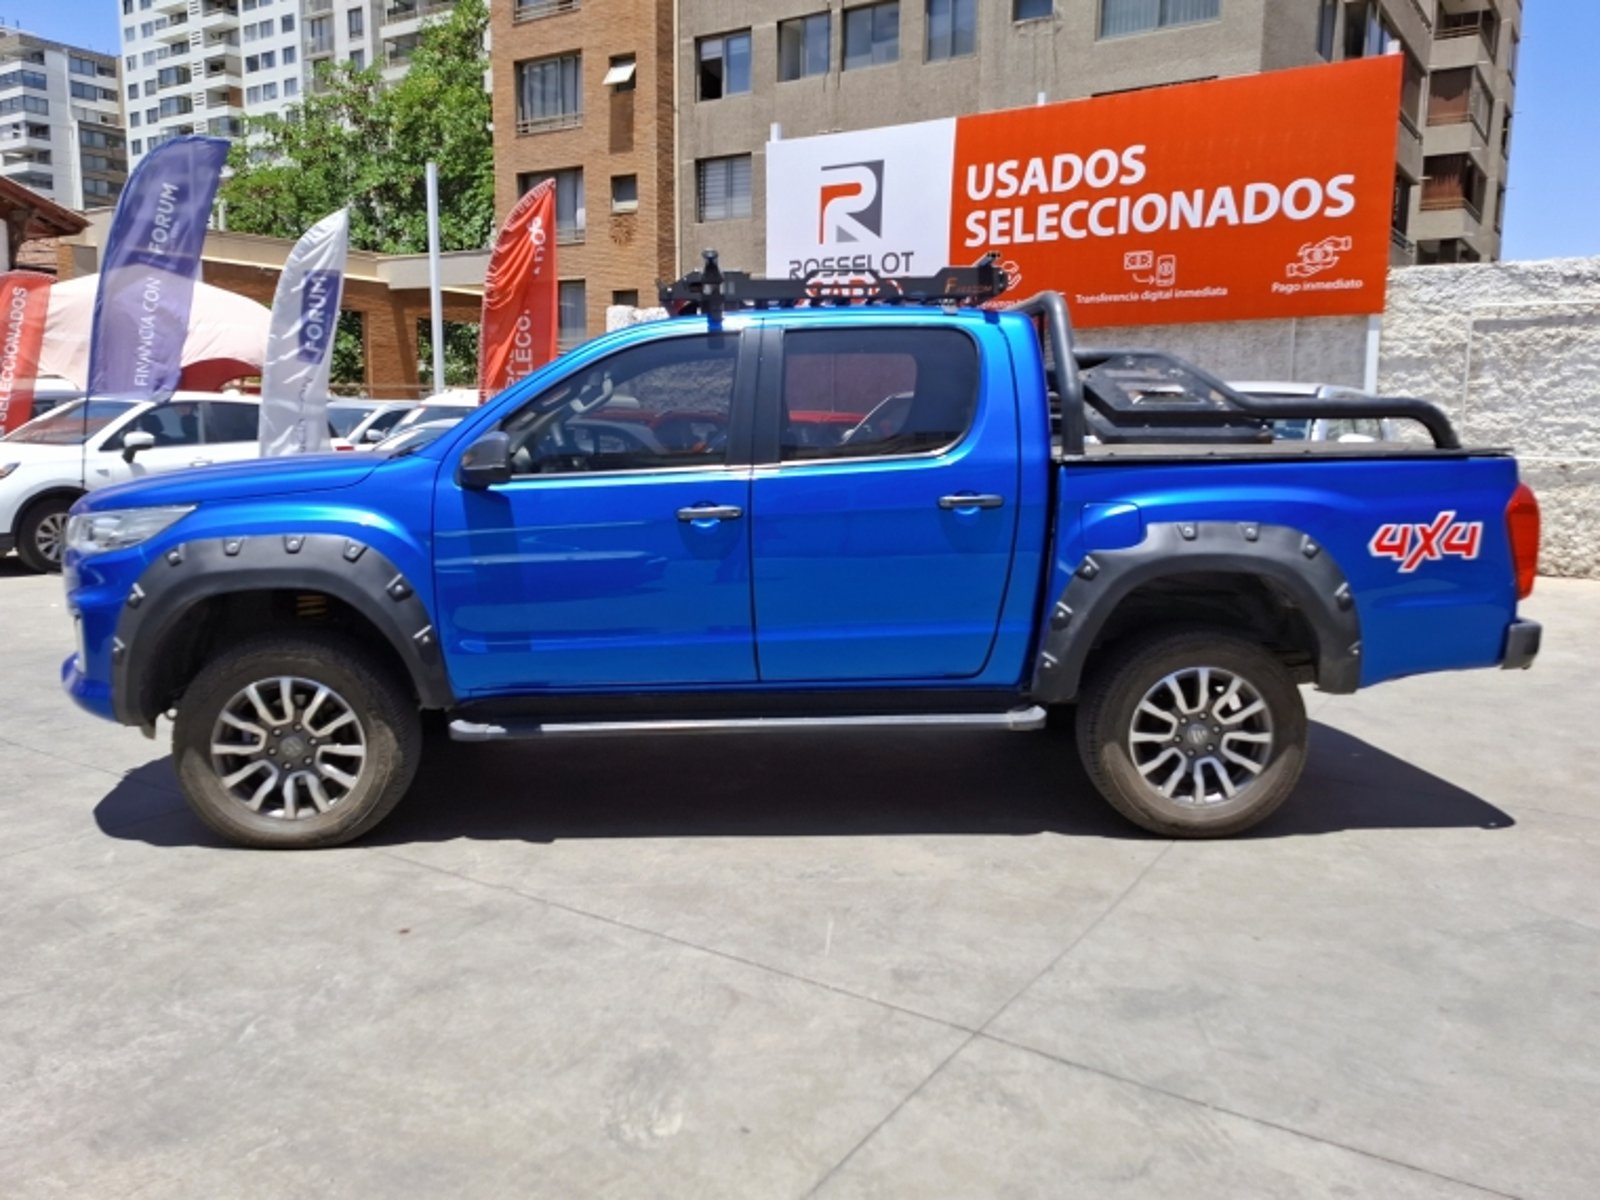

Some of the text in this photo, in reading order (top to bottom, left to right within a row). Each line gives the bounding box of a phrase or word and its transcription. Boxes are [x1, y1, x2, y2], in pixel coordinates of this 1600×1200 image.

[965, 143, 1147, 201] USADOS
[148, 182, 179, 256] FORUM
[964, 173, 1356, 248] SELECCIONADOS
[788, 251, 914, 280] ROSSELOT
[1075, 291, 1139, 305] Transferencia
[1140, 289, 1173, 302] digital
[1271, 278, 1363, 295] Pago inmediato
[134, 277, 162, 387] FINANCIA CON
[305, 275, 328, 352] FORUM
